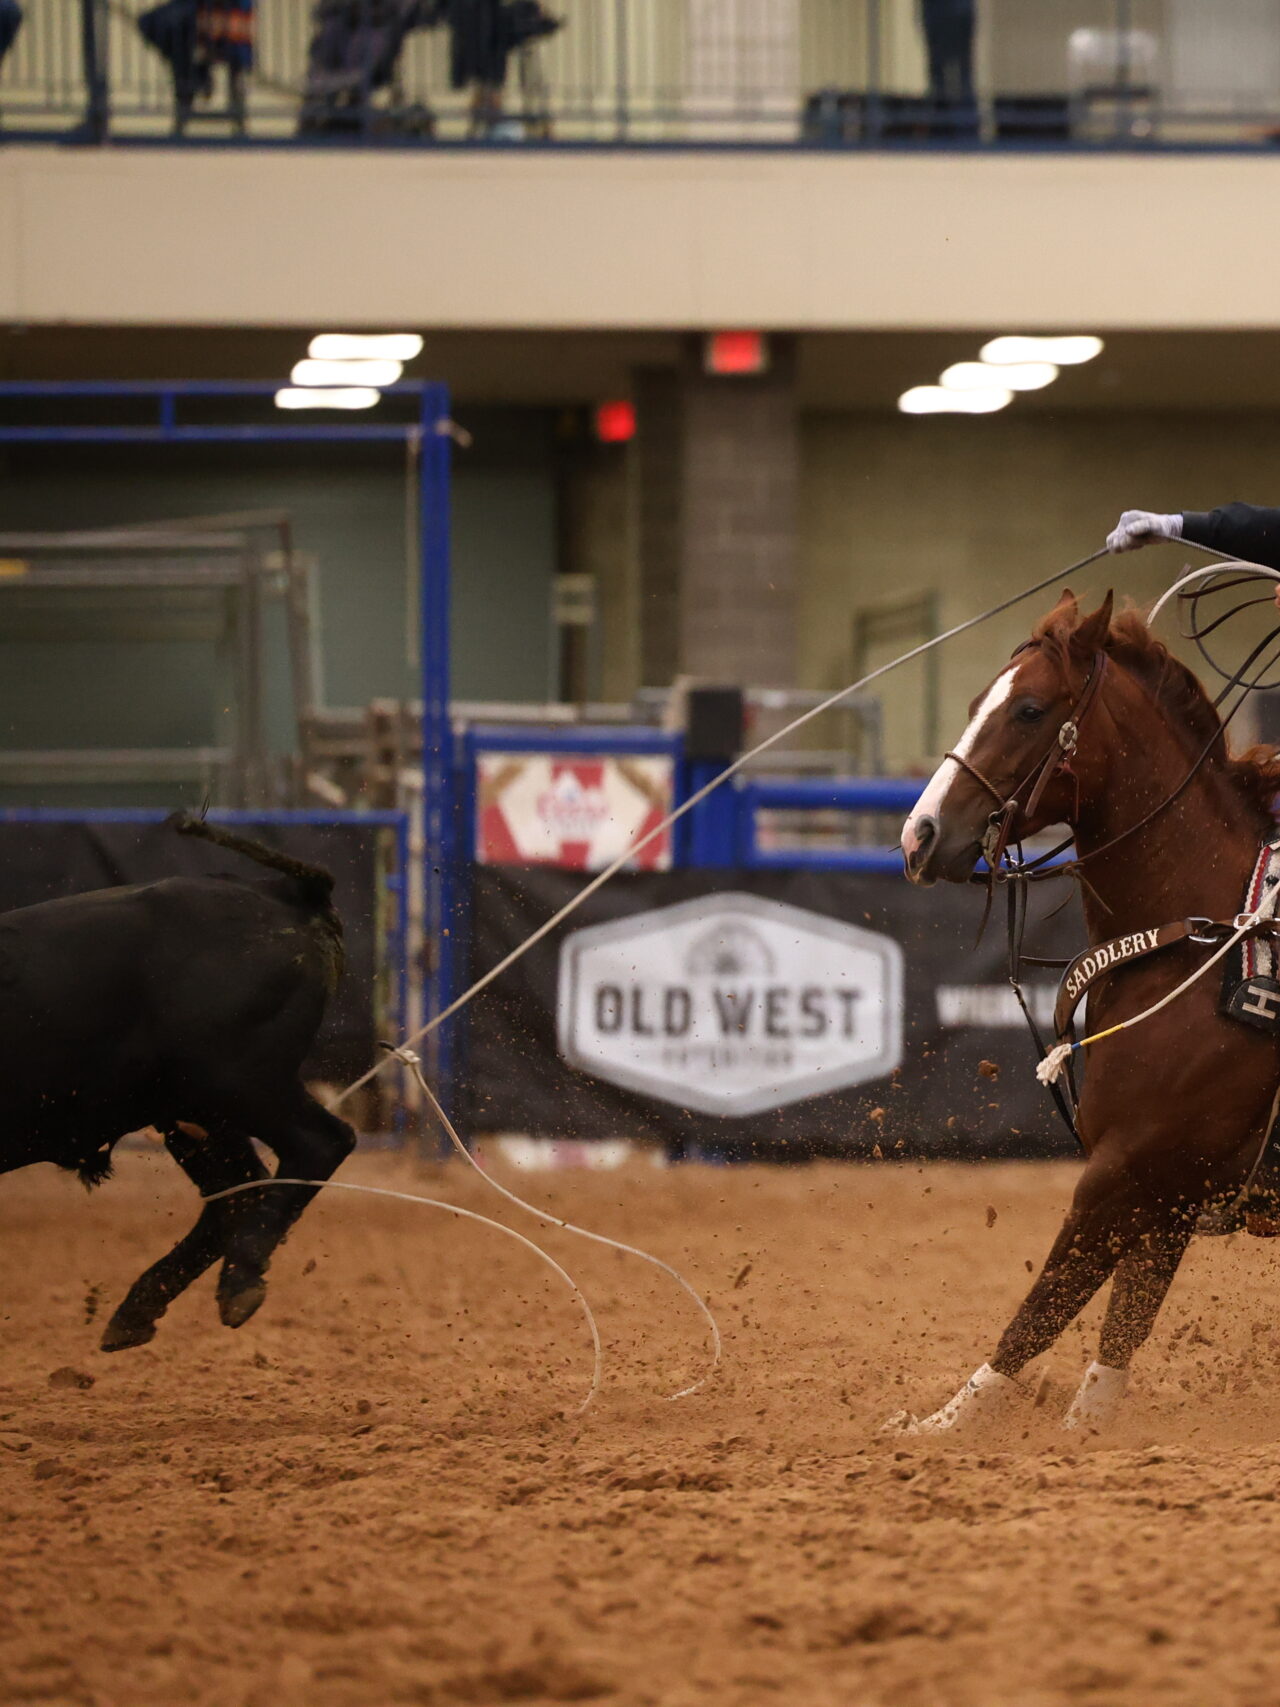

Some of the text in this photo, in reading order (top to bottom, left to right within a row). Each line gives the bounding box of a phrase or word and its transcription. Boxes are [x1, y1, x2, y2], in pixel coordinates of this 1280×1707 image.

[1066, 928, 1160, 999] SADDLERY
[594, 984, 861, 1038] OLD WEST
